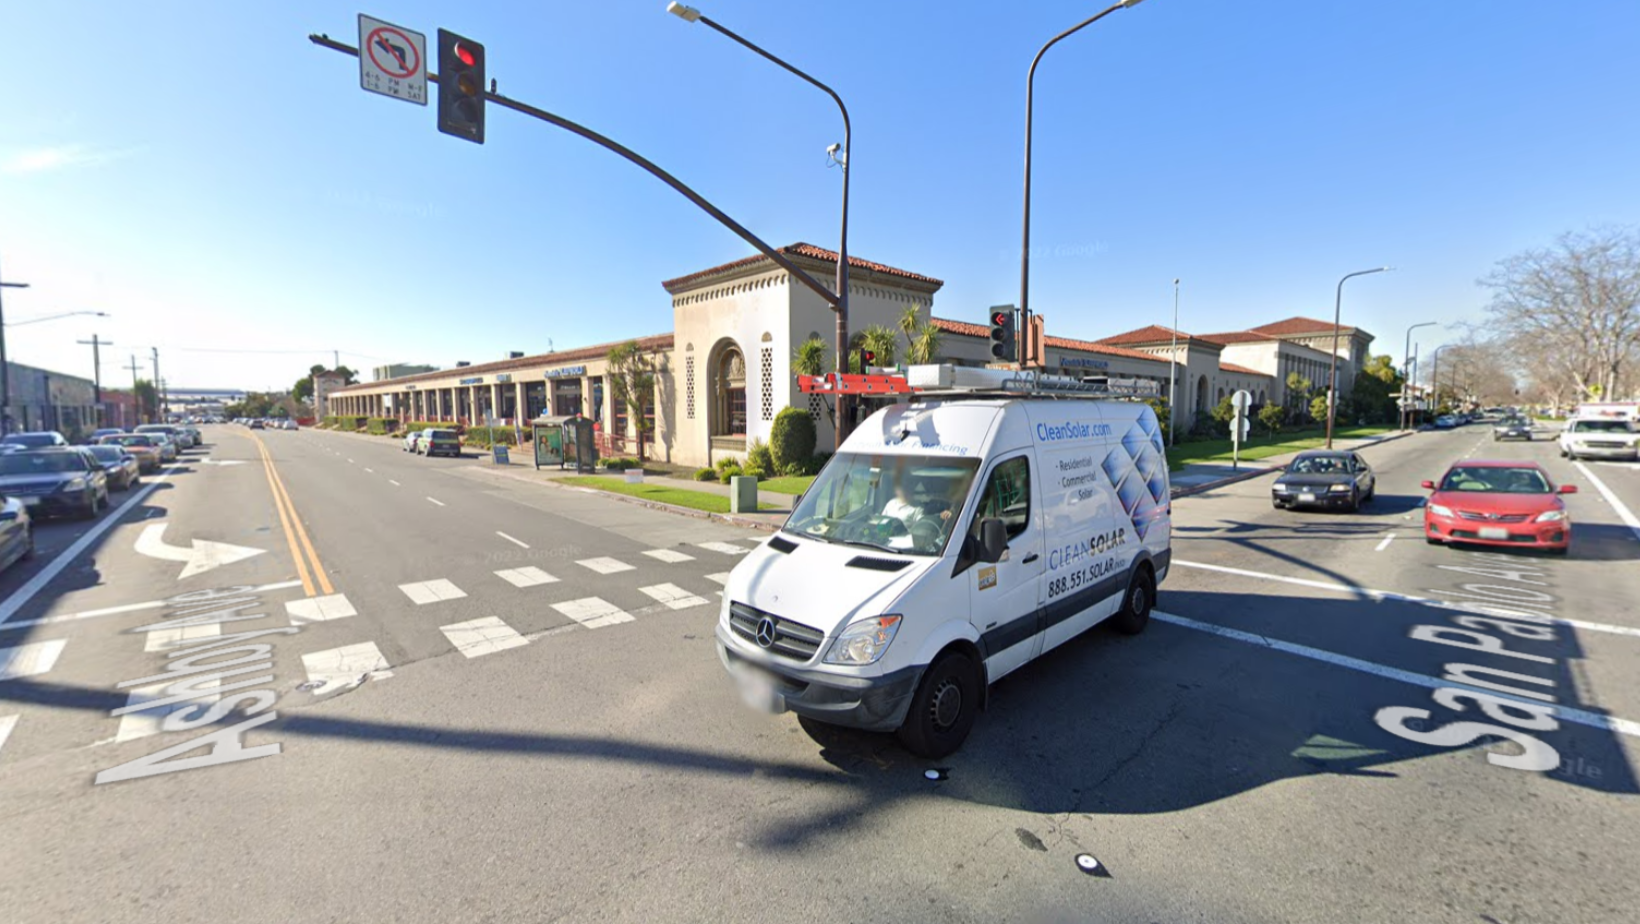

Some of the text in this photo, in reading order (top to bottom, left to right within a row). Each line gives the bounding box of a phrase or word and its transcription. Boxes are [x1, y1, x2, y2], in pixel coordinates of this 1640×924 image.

[407, 91, 421, 100] SAT
[1036, 421, 1112, 442] CleanSolar.com
[1059, 456, 1093, 471] Residential
[1061, 470, 1096, 489] Commercial
[1078, 488, 1094, 501] Solar
